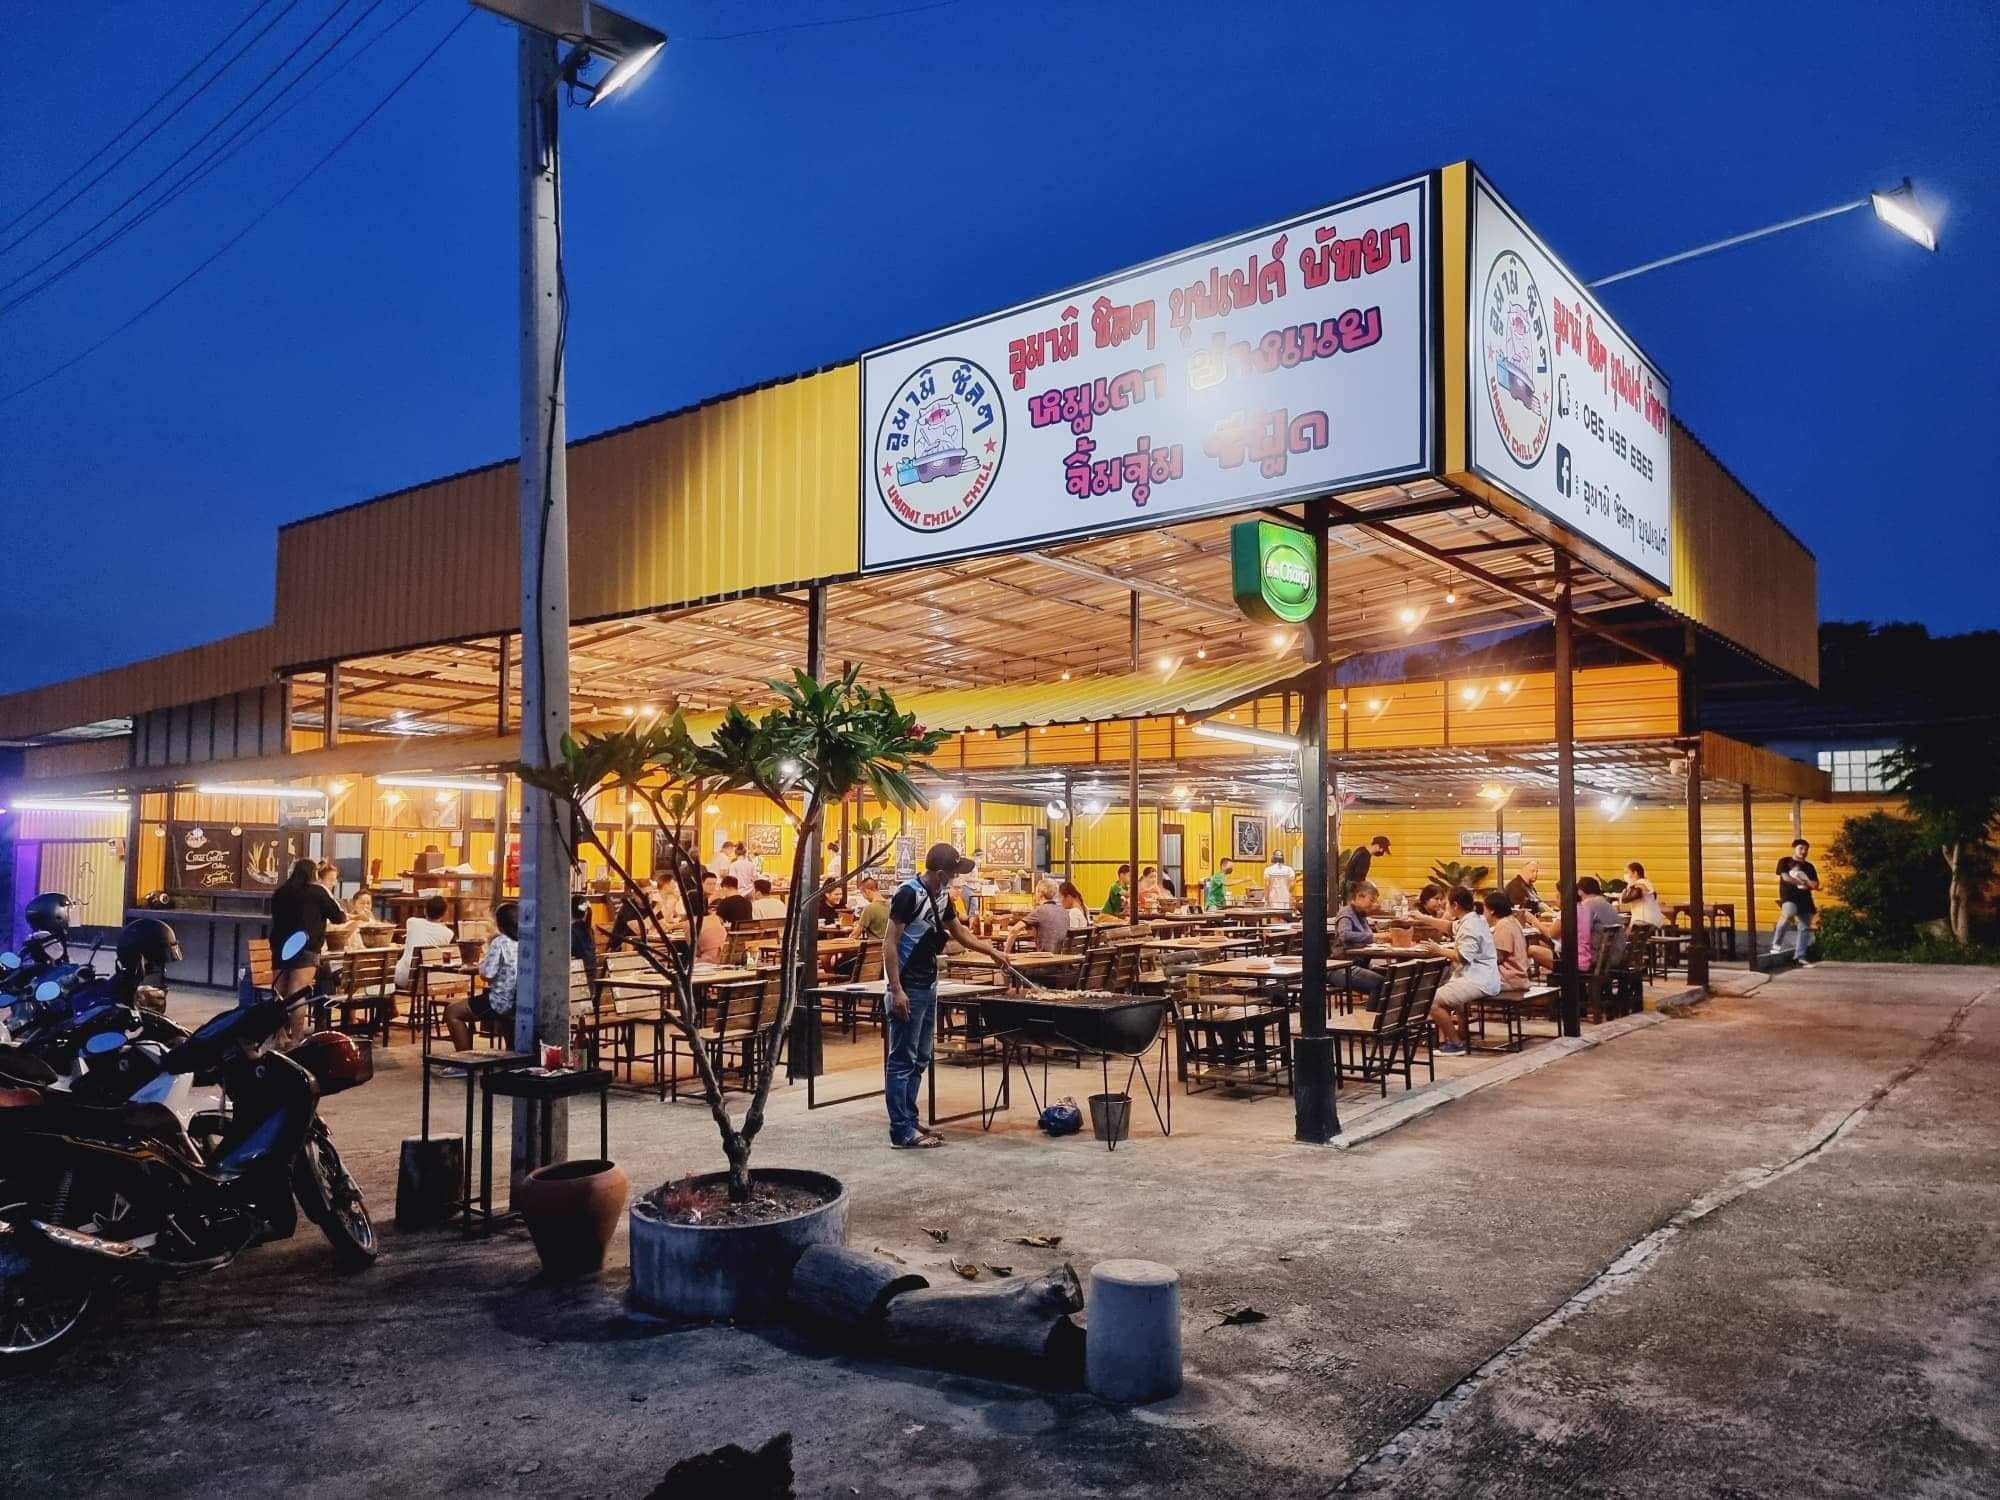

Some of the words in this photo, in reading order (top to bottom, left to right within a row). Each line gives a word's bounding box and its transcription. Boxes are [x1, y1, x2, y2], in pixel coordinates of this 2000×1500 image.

[1009, 305, 1079, 391] อูมามิ
[1091, 296, 1155, 350] ชิลๆ
[1300, 222, 1411, 289] พัทยา
[886, 368, 935, 451] อูมามิ
[952, 364, 994, 434] ชิลๆ
[1490, 376, 1510, 442] UMAMI
[1511, 436, 1532, 460] CHILL
[1532, 416, 1547, 455] CHILL
[1583, 404, 1604, 443] 085
[1608, 426, 1627, 461] 439
[1630, 443, 1653, 482] 6969
[887, 485, 921, 524] UMAMI
[923, 506, 961, 526] CHILL
[962, 461, 993, 508] CHILL
[1063, 436, 1184, 507] จิ้มจุ่ม
